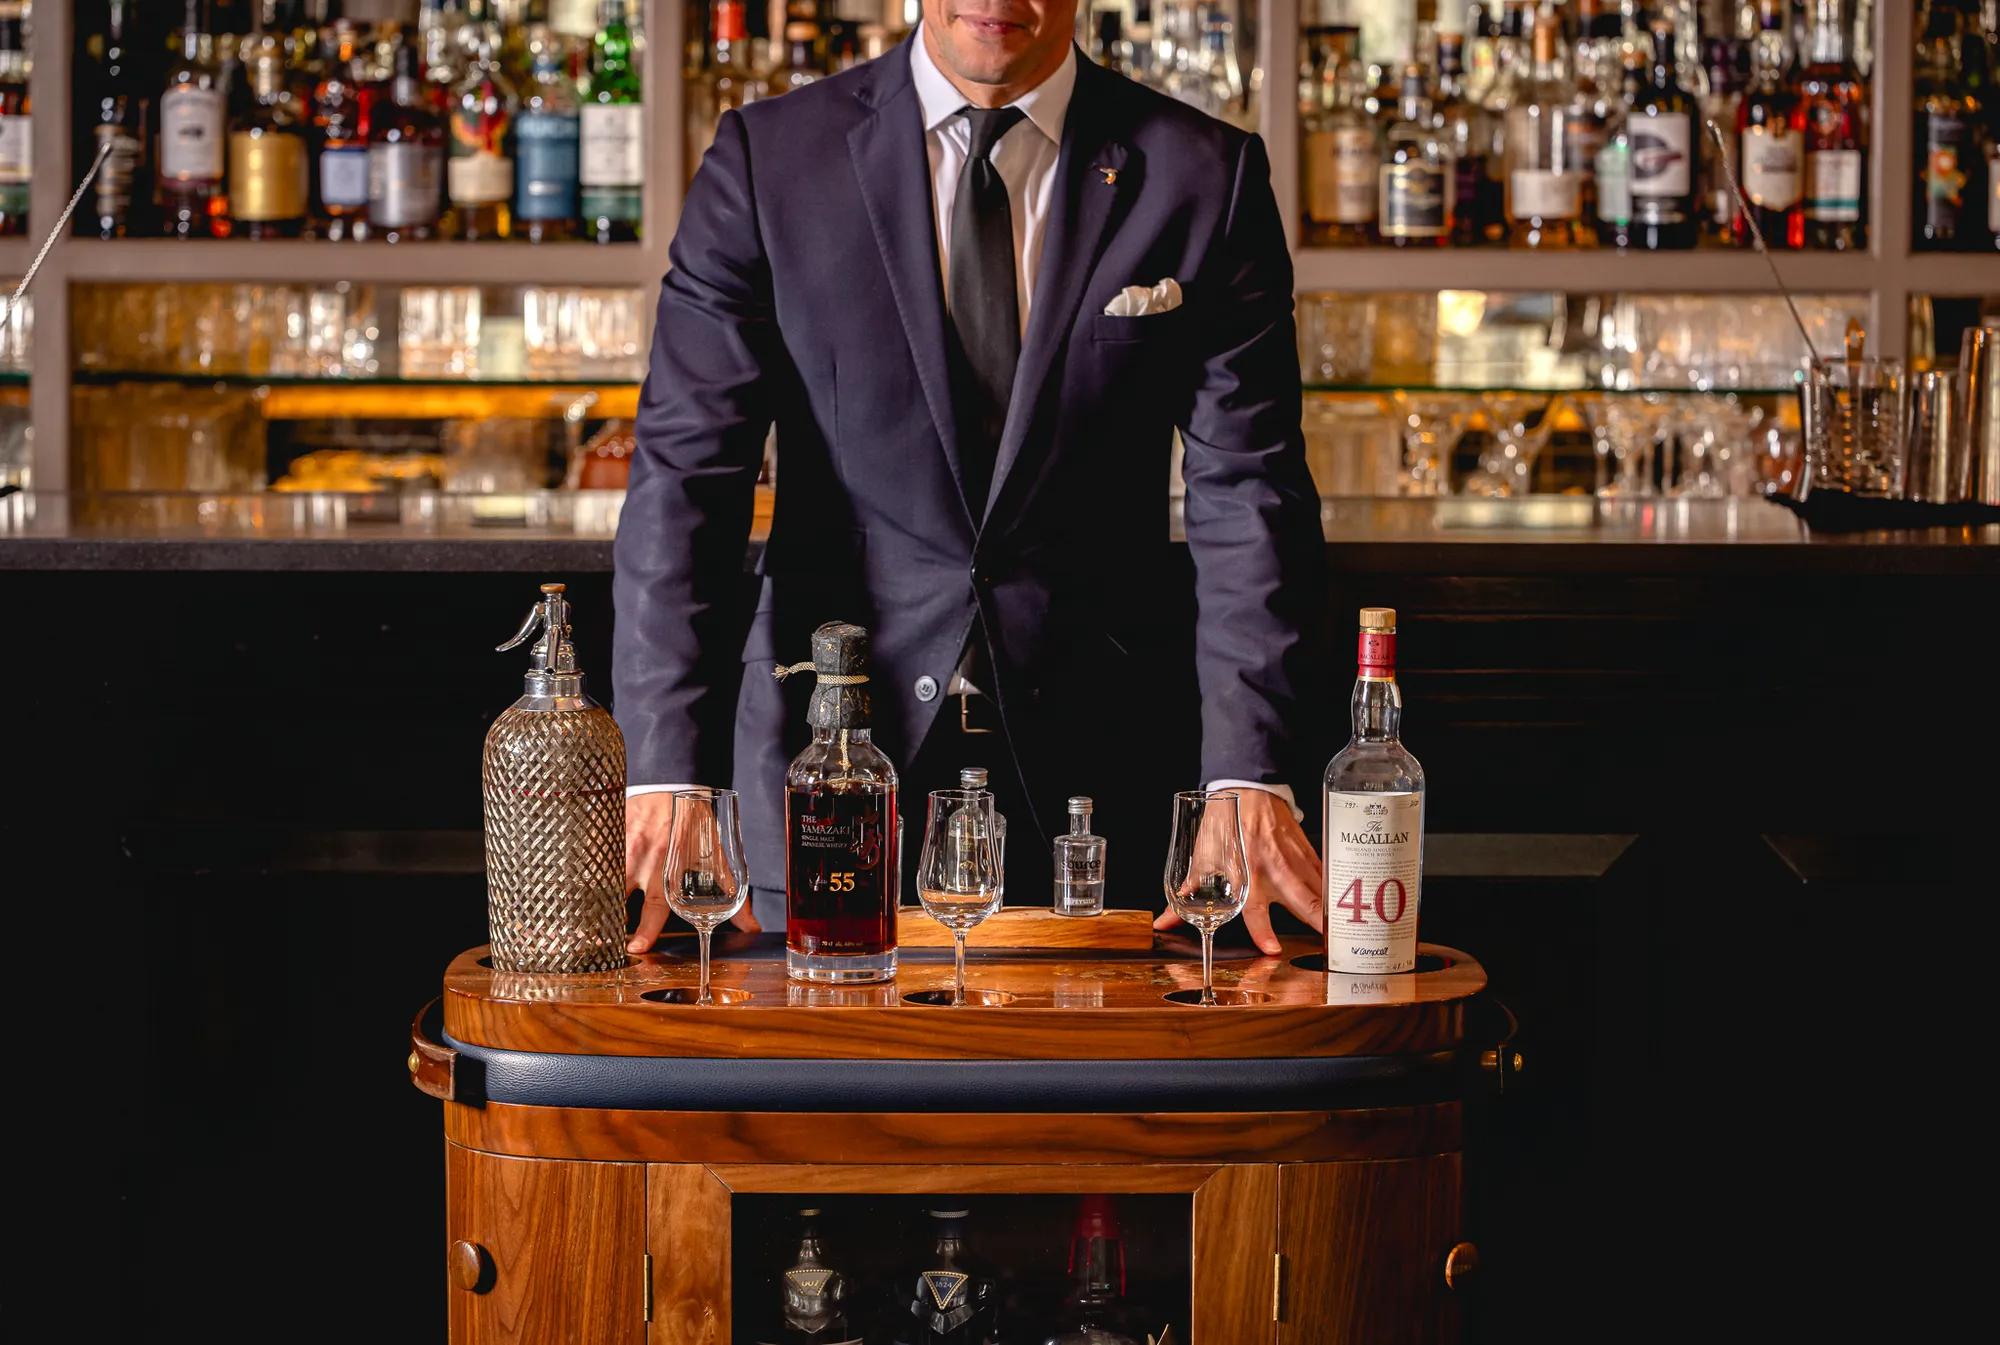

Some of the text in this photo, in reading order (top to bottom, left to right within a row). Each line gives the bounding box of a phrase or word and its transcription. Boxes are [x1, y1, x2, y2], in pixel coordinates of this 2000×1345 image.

[801, 814, 817, 823] THE
[801, 824, 850, 835] YAMAZAKI
[1365, 820, 1384, 833] The
[1341, 832, 1409, 845] MACALLAN
[829, 872, 855, 892] 55
[1336, 878, 1407, 925] 40
